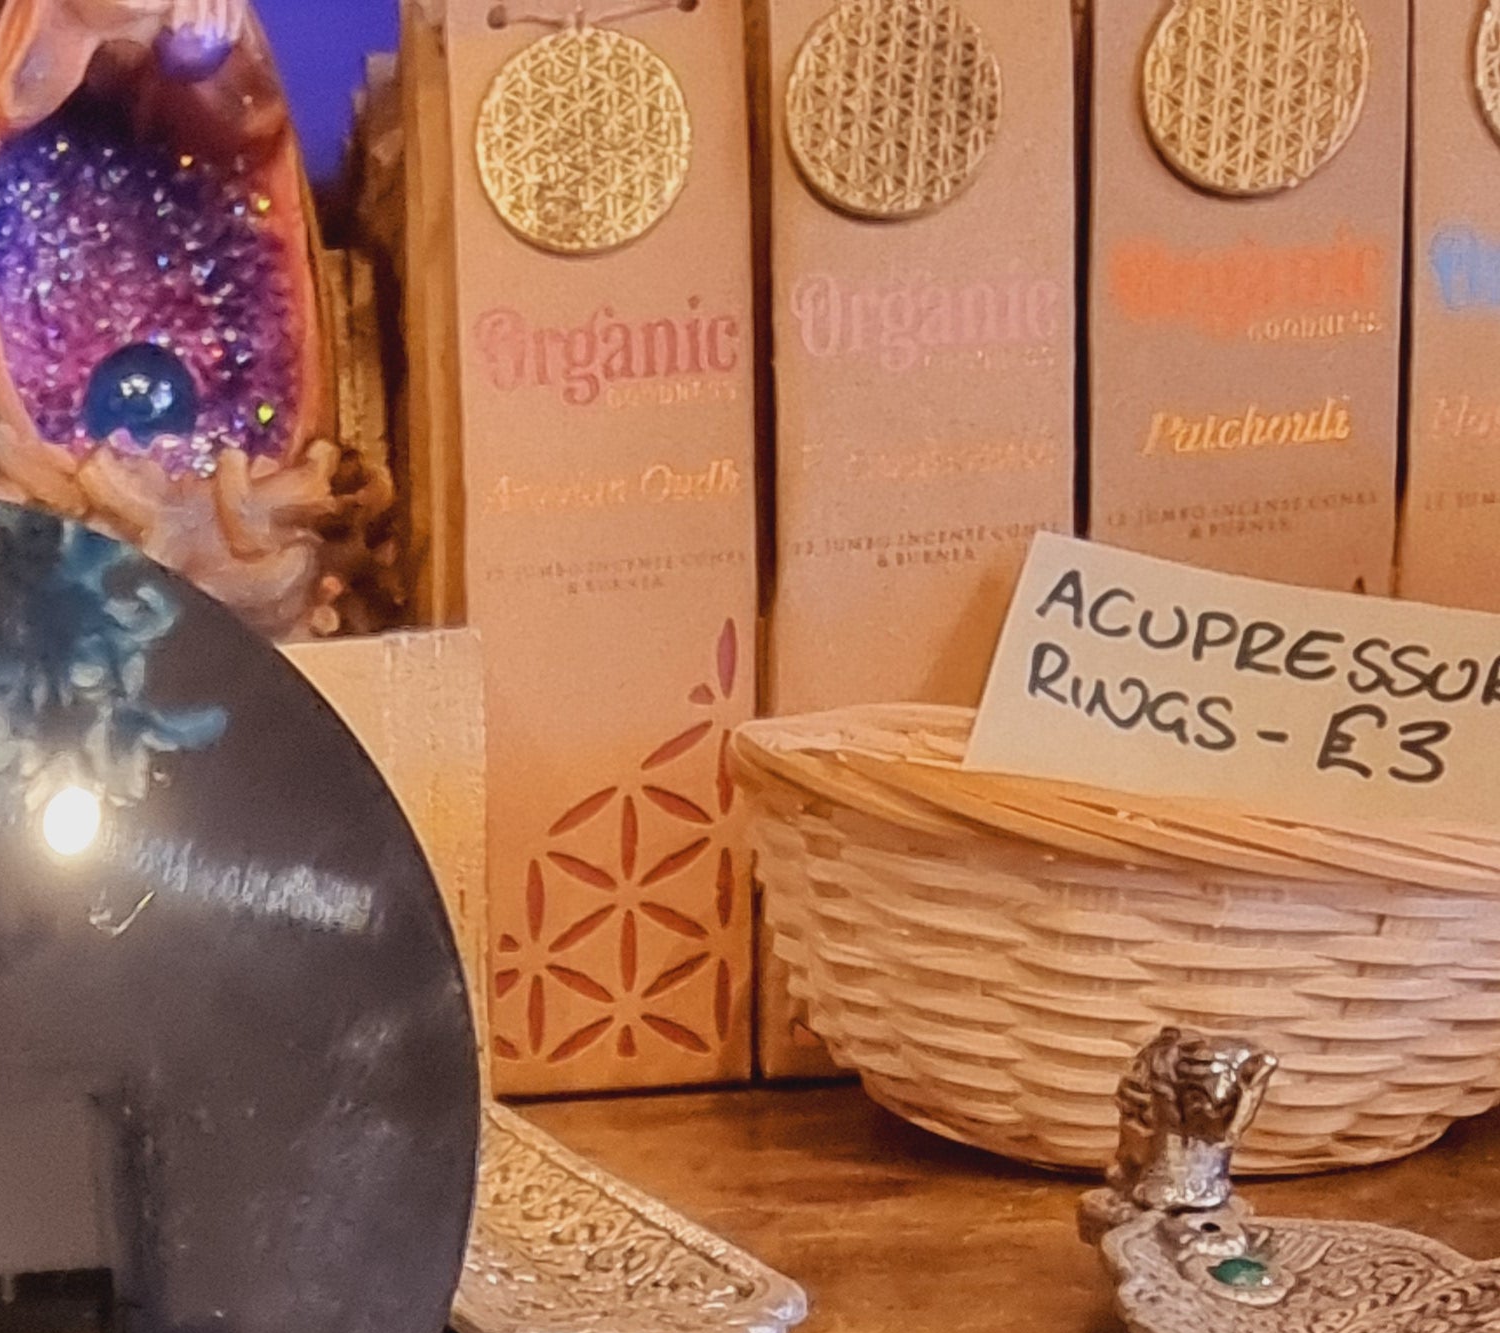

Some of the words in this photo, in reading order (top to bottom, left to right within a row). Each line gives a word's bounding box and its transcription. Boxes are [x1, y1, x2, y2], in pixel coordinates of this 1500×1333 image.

[473, 296, 739, 406] Organic
[791, 259, 1060, 371] Organic
[1143, 395, 1351, 455] Patchouli
[1027, 641, 1237, 752] RINGS
